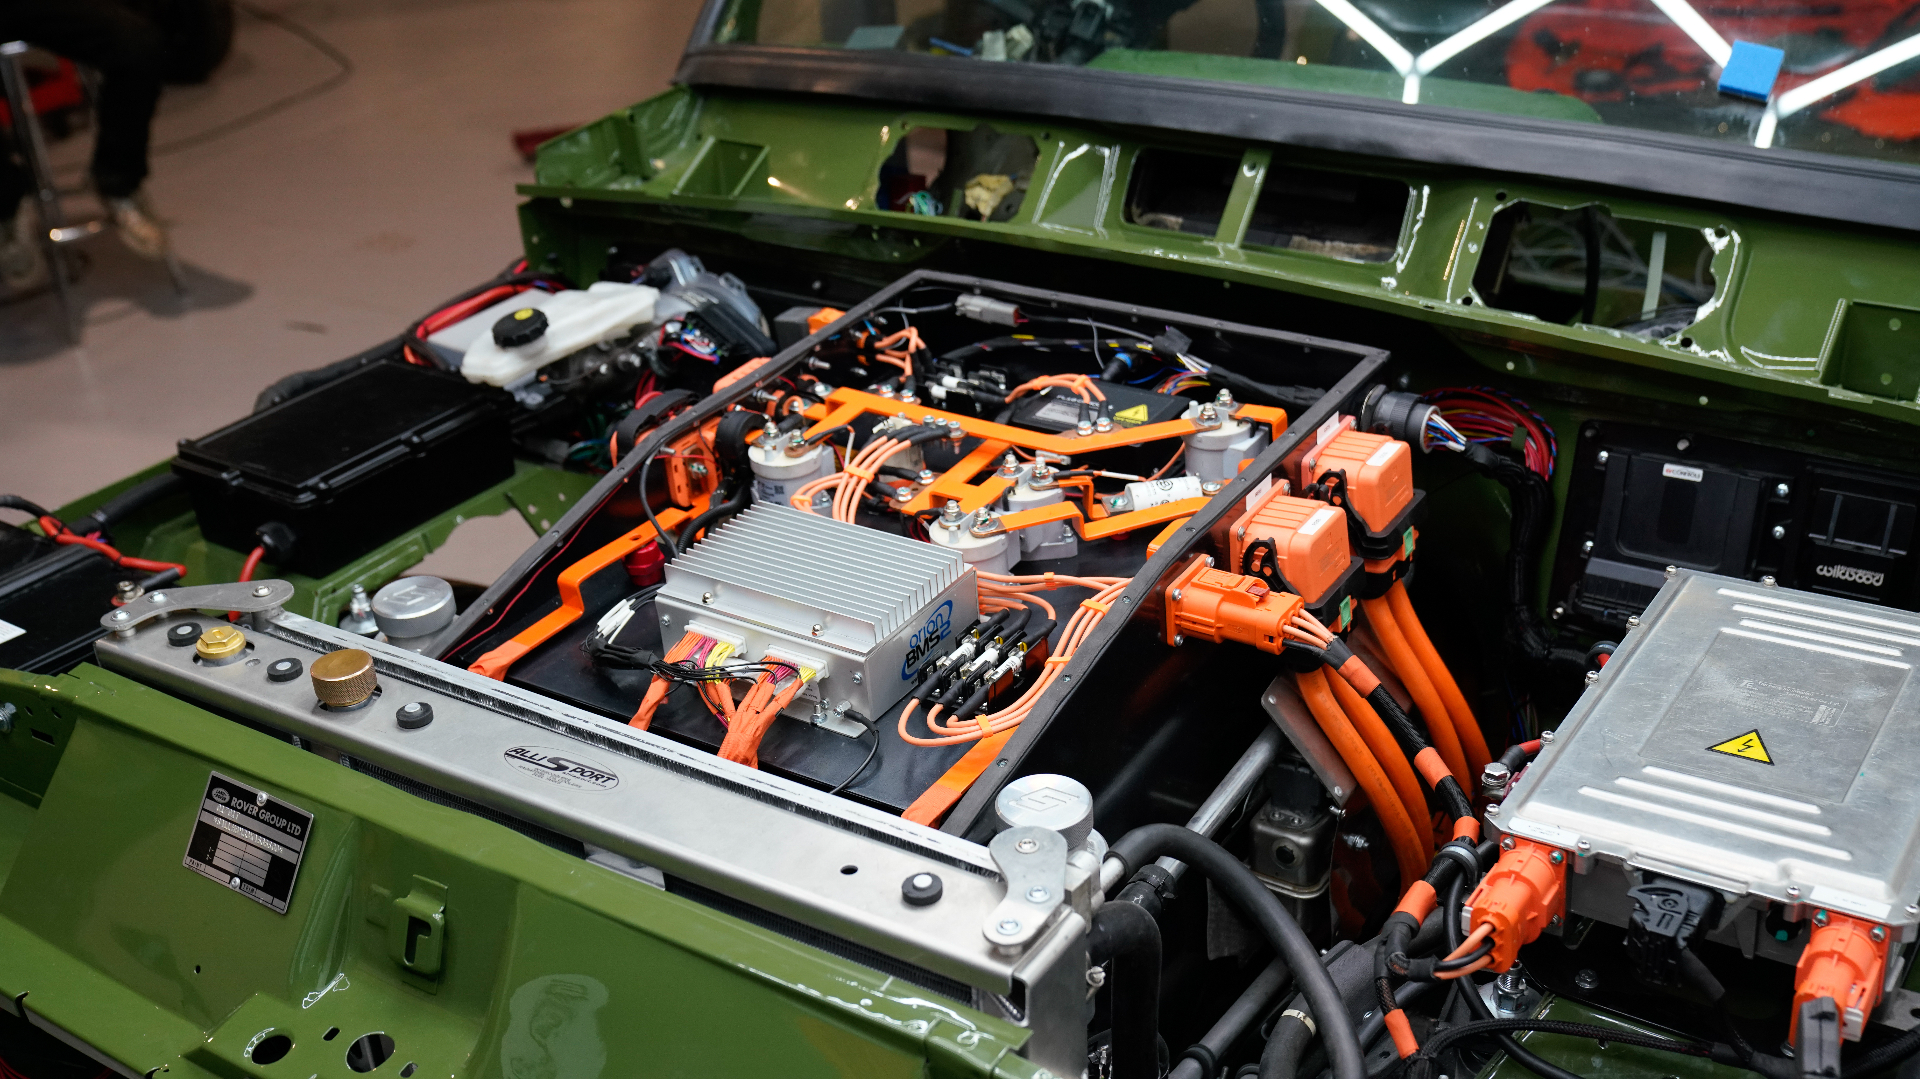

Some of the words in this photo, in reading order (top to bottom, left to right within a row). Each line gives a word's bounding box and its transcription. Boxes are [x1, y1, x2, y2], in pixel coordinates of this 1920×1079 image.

[1815, 564, 1885, 588] wilwood
[230, 796, 258, 816] ROVER
[258, 809, 287, 828] GROUP
[286, 821, 302, 836] LTD
